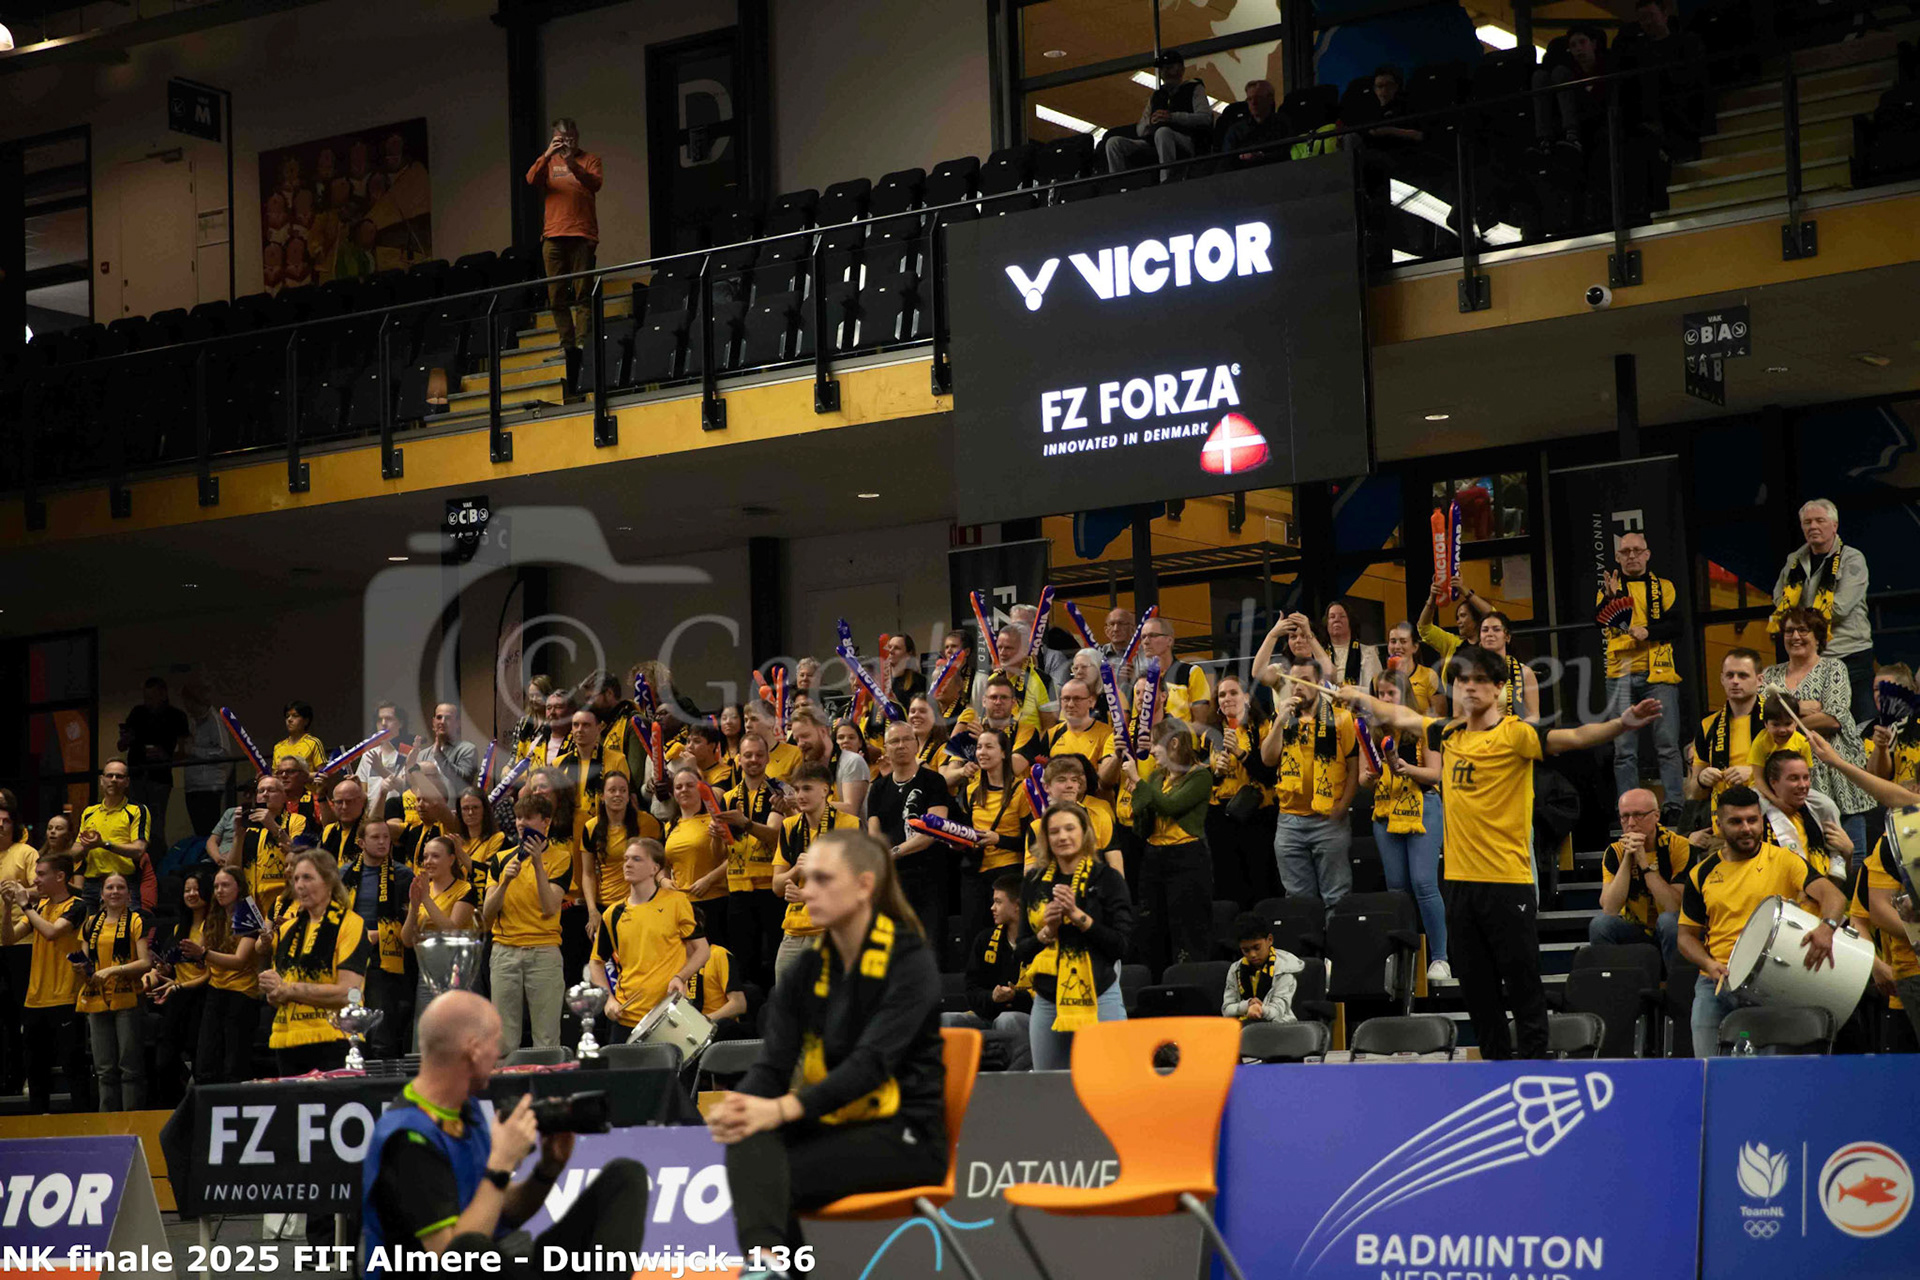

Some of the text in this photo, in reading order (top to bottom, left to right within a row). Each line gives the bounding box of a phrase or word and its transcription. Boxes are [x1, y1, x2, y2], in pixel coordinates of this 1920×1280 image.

[1068, 221, 1273, 300] VICTOR
[1708, 315, 1722, 323] VAK
[1041, 387, 1088, 433] FZ
[1043, 422, 1209, 456] INNOVATED IN DENMARK
[1434, 532, 1447, 584] VICTOR
[1592, 513, 1607, 588] INNOVATE
[857, 664, 891, 706] VICTOR
[1103, 683, 1125, 737] VICTOR
[1137, 684, 1156, 733] VICTOR
[941, 819, 979, 841] VICTOR
[208, 1105, 277, 1165] FZ
[0, 1173, 113, 1228] TOR
[204, 1183, 351, 1200] INNOVATED IN
[1740, 1206, 1785, 1217] TeamNL
[1356, 1234, 1602, 1269] BADMINTON
